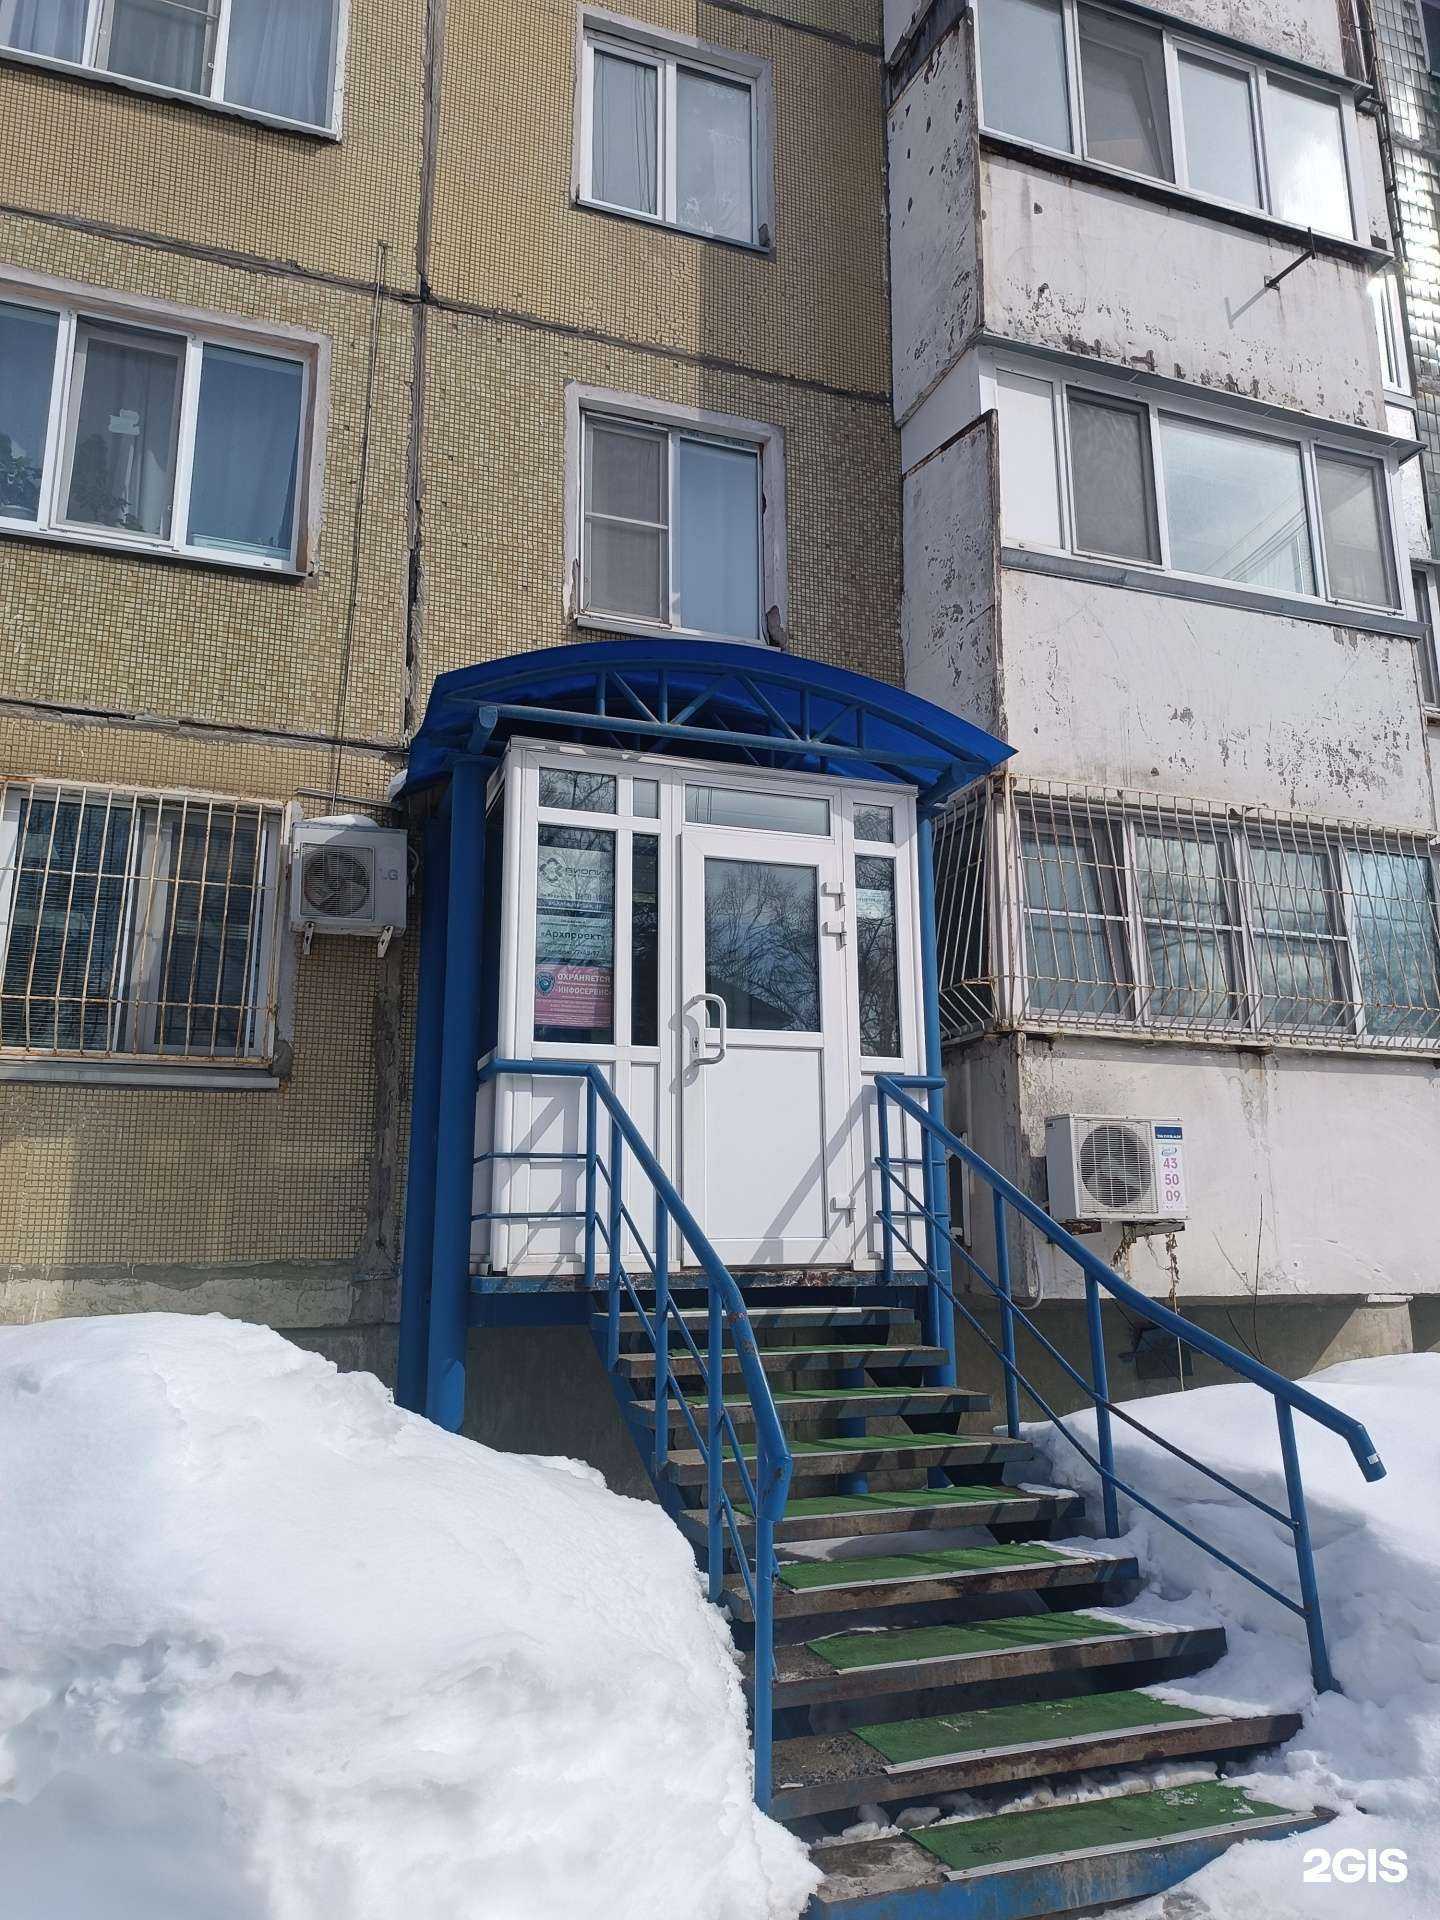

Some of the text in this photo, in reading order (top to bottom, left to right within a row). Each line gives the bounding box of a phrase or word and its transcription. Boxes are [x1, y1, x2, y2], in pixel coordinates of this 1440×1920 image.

[558, 973, 610, 984] ОХРАНЯЕТСЯ
[1163, 1157, 1178, 1169] 43
[1165, 1173, 1180, 1186] 50
[1166, 1190, 1181, 1202] 09
